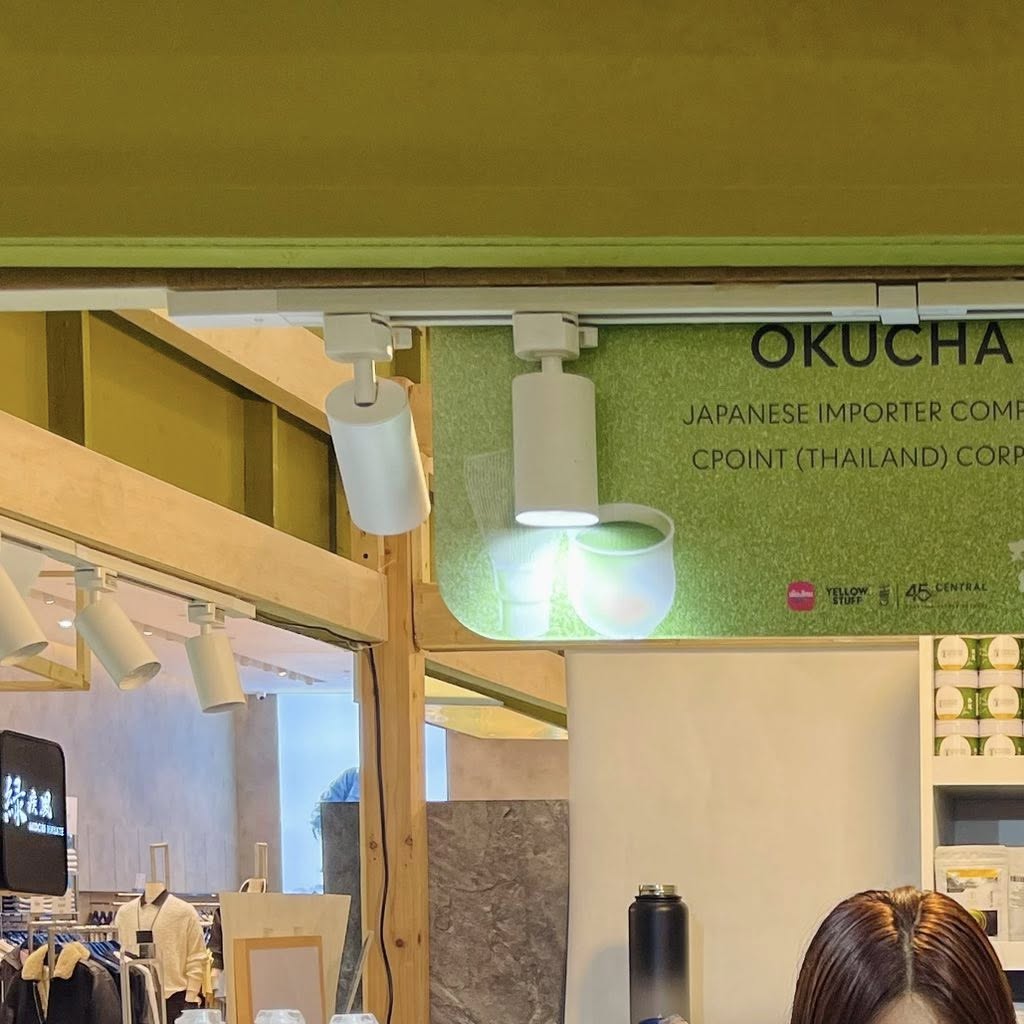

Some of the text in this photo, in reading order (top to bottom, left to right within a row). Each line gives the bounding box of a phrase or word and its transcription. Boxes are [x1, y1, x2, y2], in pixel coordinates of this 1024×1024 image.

[751, 320, 1014, 369] OKUCHA
[683, 403, 808, 425] JAPANESE
[819, 402, 942, 423] IMPORTER
[692, 448, 788, 470] CPOINT
[796, 445, 948, 472] (THAILAND)
[826, 587, 869, 597] YELLOW
[936, 583, 988, 592] CENTRAL
[832, 596, 863, 605] STUFF
